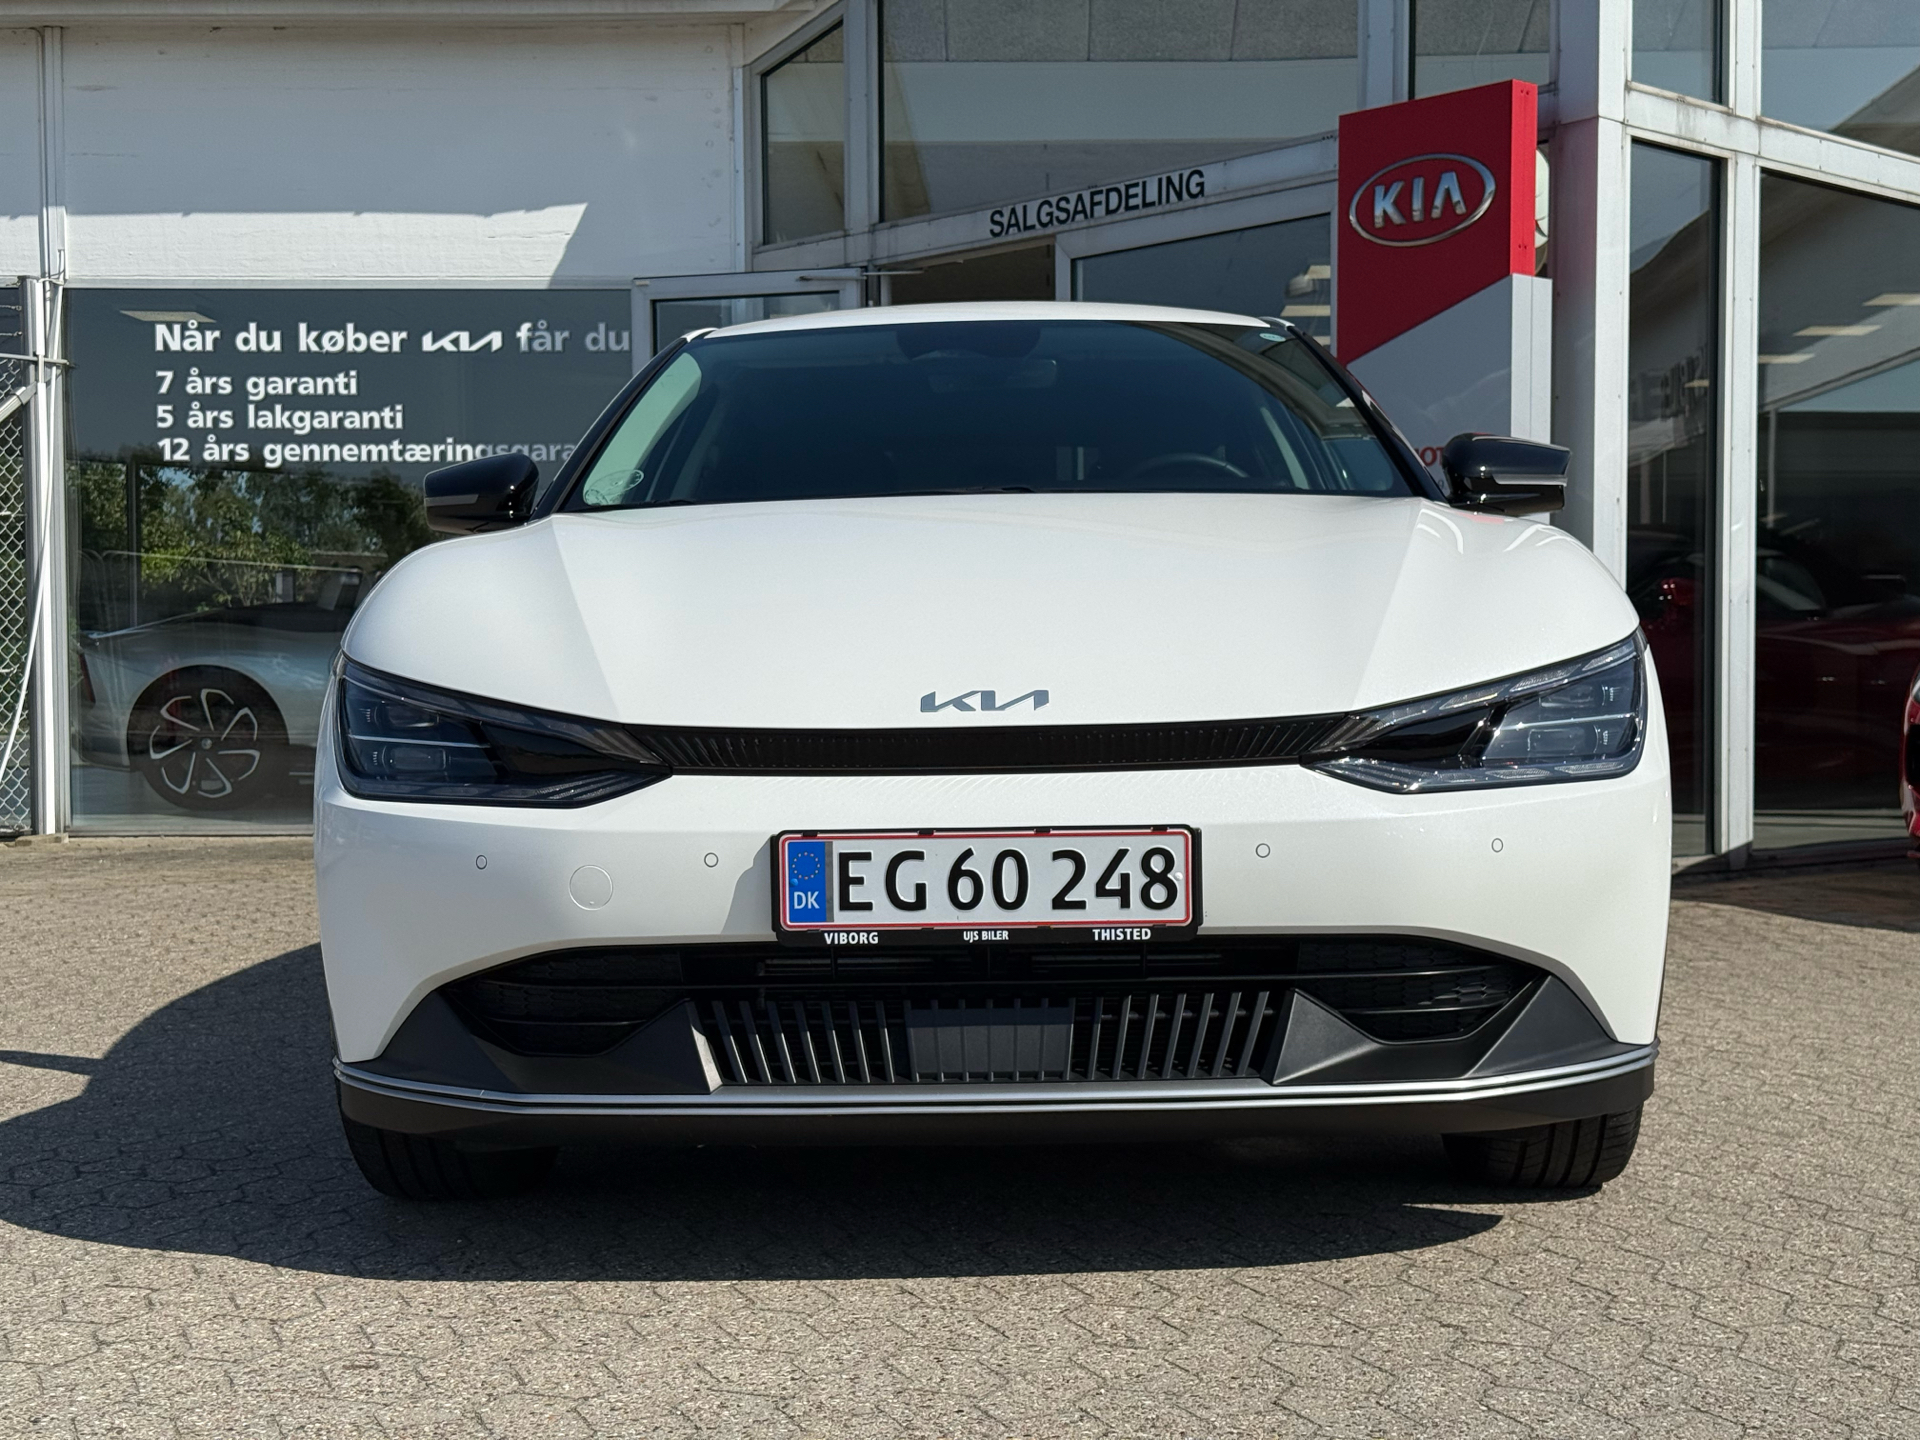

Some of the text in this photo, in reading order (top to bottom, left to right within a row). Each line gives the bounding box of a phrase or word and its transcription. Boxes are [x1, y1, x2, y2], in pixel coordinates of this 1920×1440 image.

[989, 169, 1205, 238] SALGSAFDELING
[1374, 171, 1467, 229] KIA
[155, 319, 220, 351] Når
[235, 323, 281, 351] du
[299, 323, 407, 352] køber
[516, 319, 570, 352] får
[585, 322, 630, 352] du
[156, 366, 357, 402] 7 års garanti
[157, 400, 403, 435] 5 års lakgaranti
[158, 438, 190, 461] 12
[203, 434, 250, 461] års
[921, 690, 1049, 713] KIA
[838, 847, 1178, 912] EG 60 248
[793, 891, 820, 909] DK
[824, 928, 1151, 945] VIBORG UJS BILER THISTED
